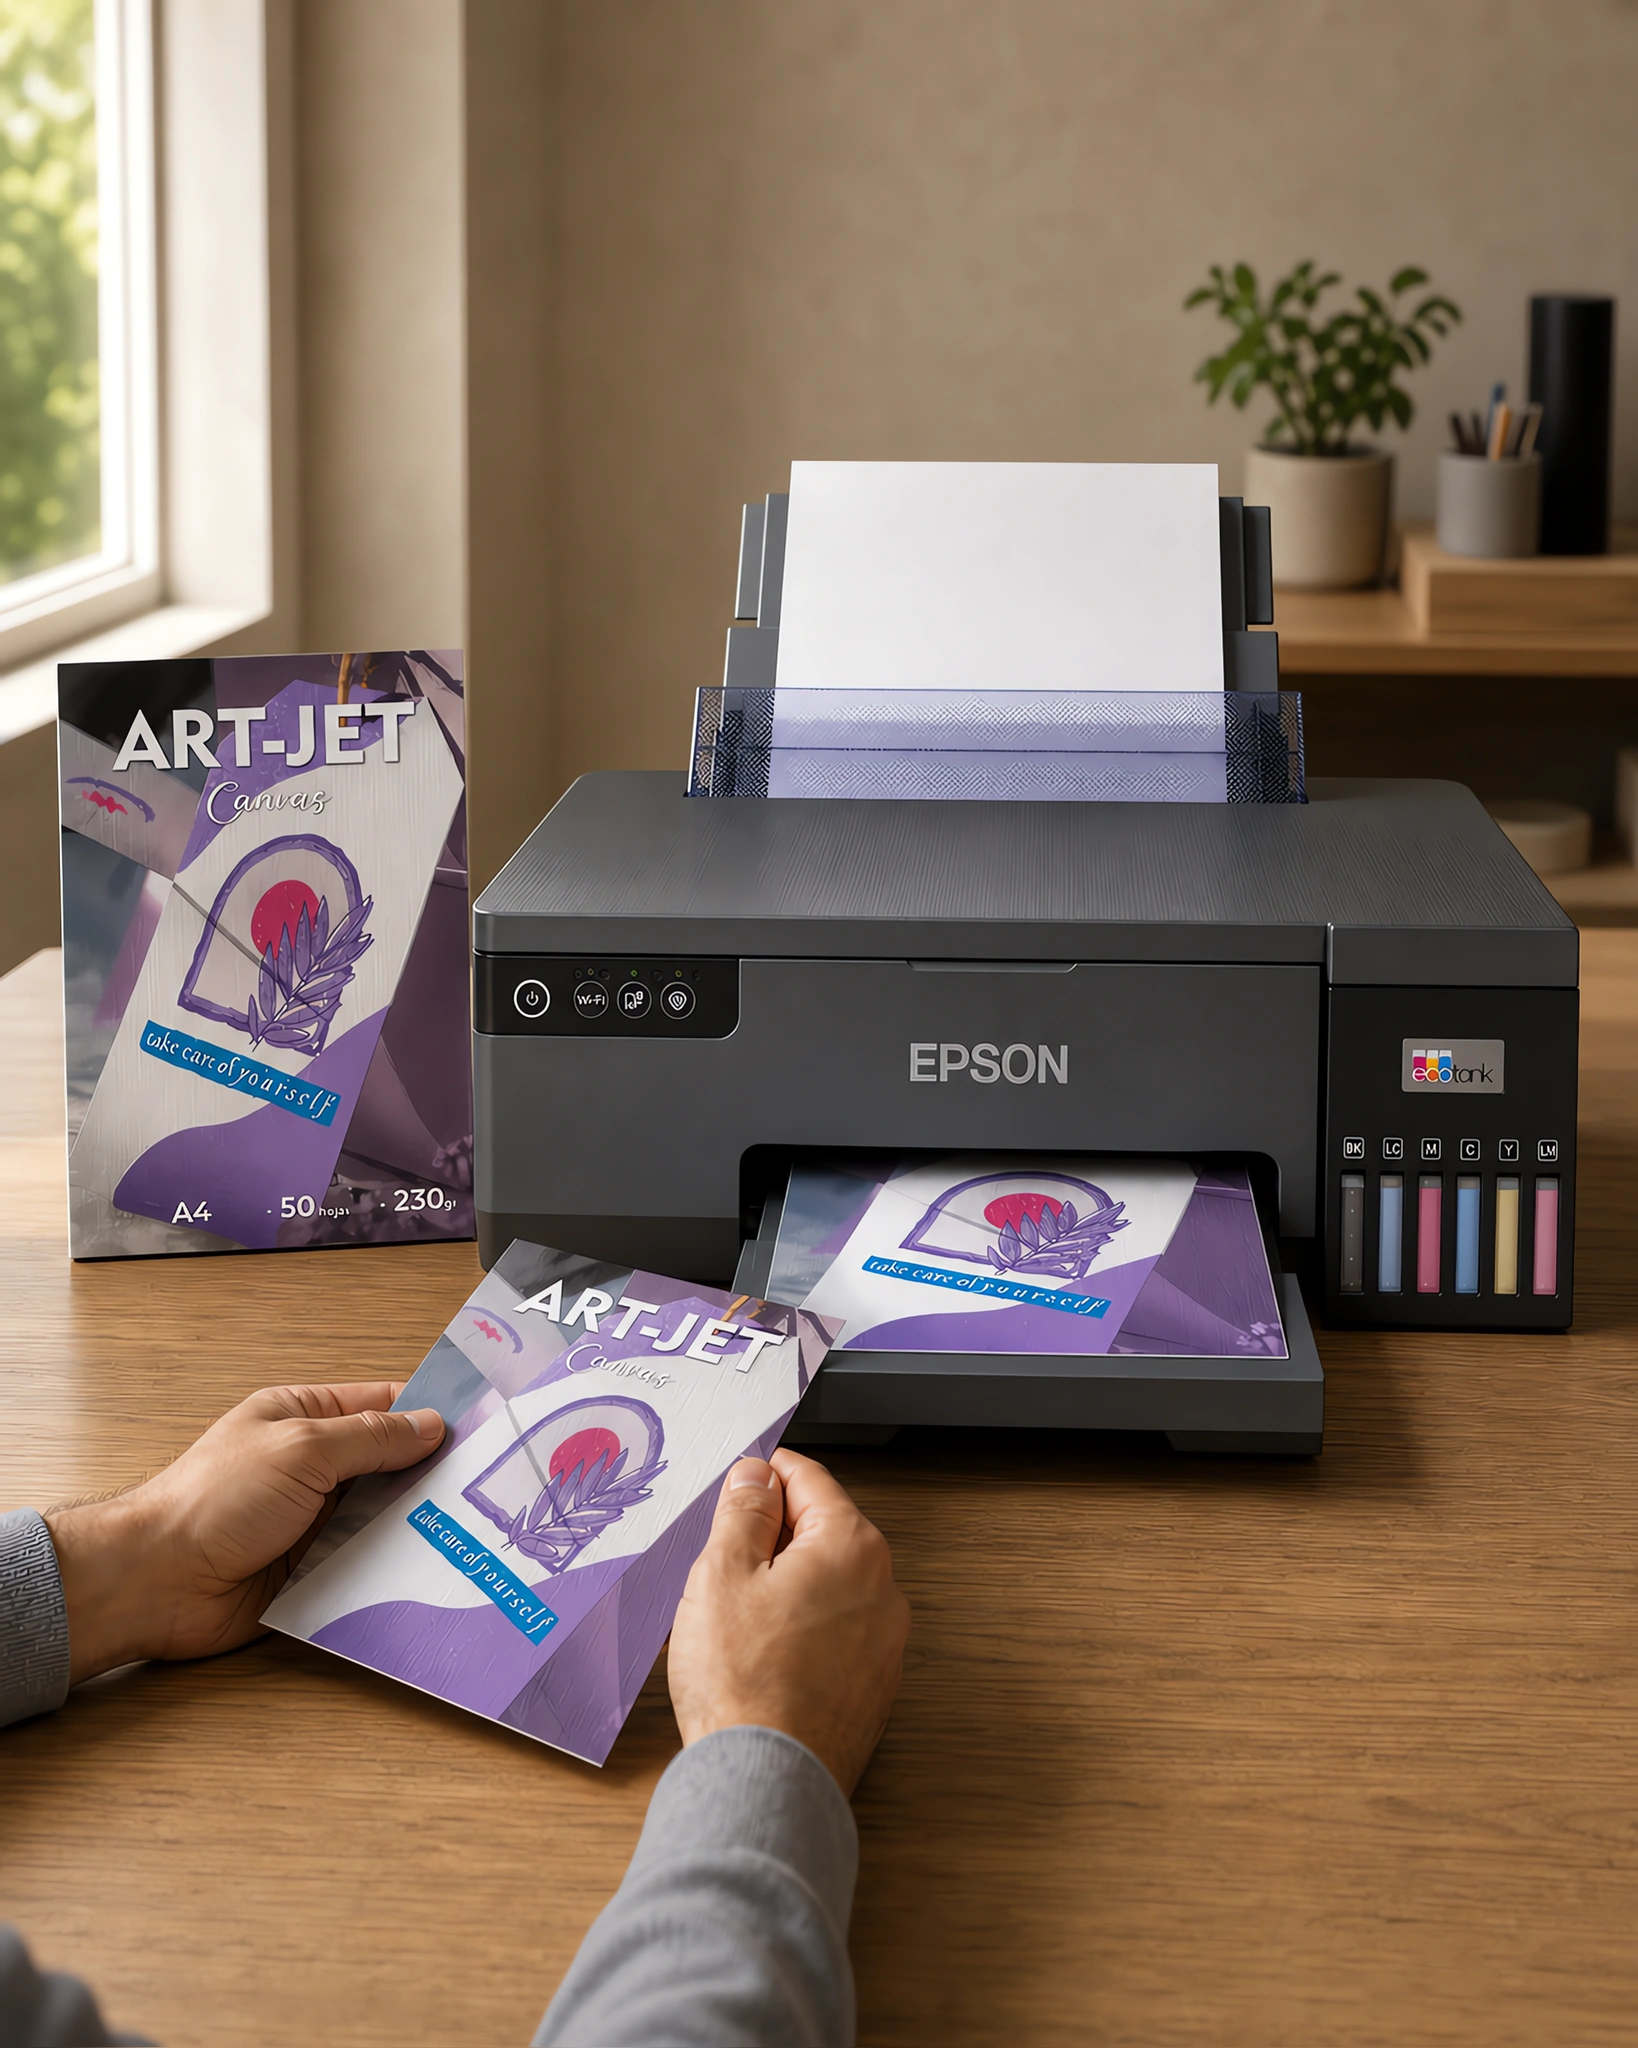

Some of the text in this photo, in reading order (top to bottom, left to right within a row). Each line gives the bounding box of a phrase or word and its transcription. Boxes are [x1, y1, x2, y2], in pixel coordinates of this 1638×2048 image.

[112, 701, 417, 771] ART-JET
[206, 781, 332, 825] Canvas
[909, 1043, 1069, 1085] EPSON
[1386, 1142, 1401, 1155] LC
[1425, 1143, 1437, 1156] M
[1465, 1143, 1476, 1156] C
[1504, 1144, 1514, 1157] Y
[1540, 1145, 1556, 1157] LM
[171, 1201, 213, 1224] A4
[280, 1195, 315, 1219] 50
[512, 1278, 788, 1374] ART-JET
